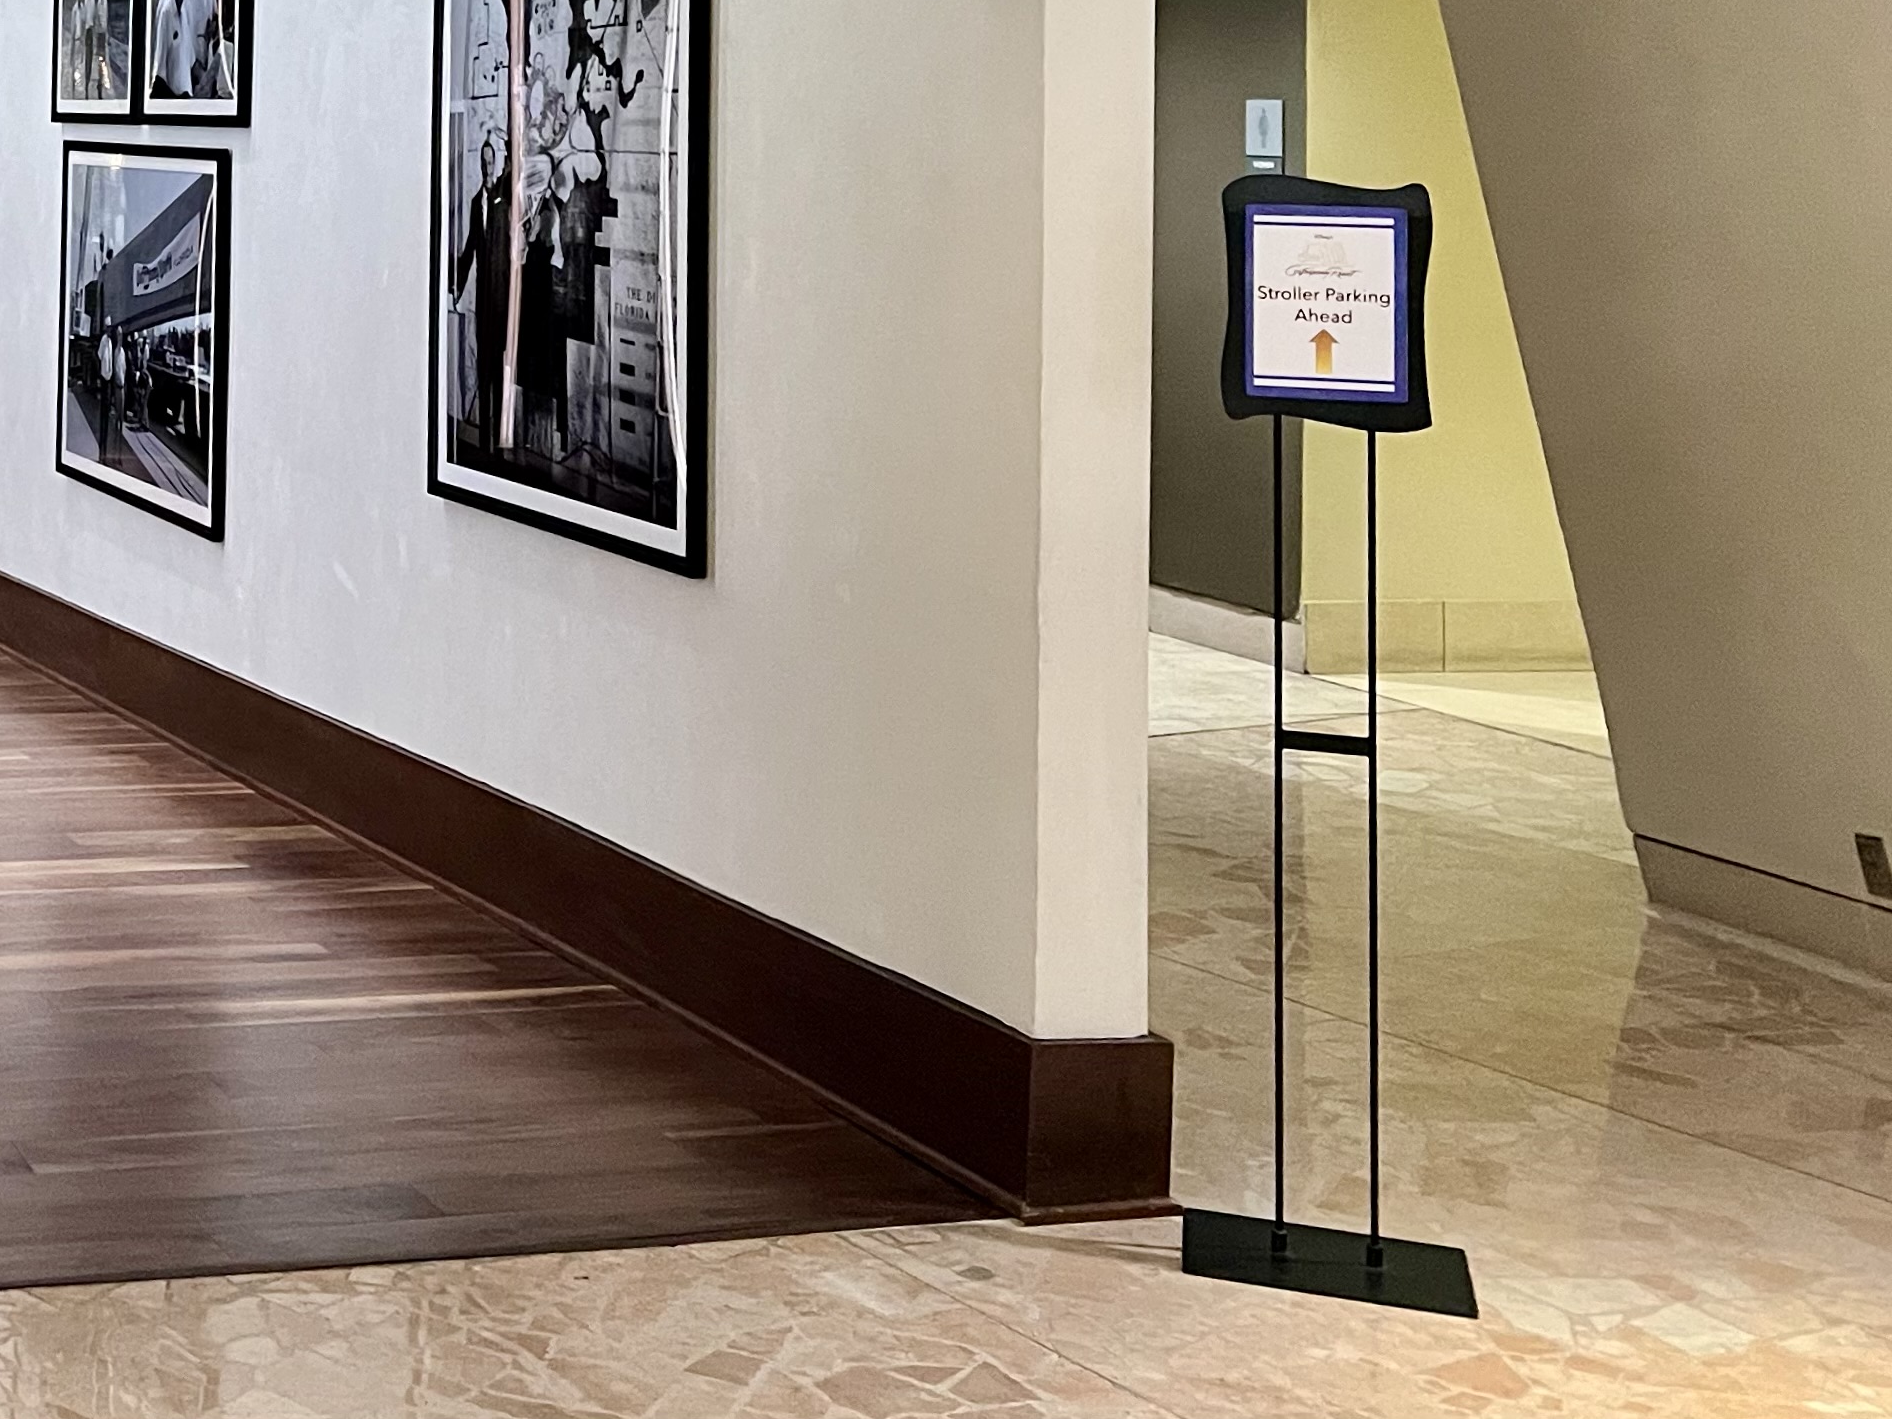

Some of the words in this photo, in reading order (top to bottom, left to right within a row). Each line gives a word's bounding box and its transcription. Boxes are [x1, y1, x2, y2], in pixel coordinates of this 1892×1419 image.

[1257, 285, 1320, 301] Stroller
[1325, 287, 1391, 308] Parking
[614, 302, 650, 321] FLORIDA
[1294, 308, 1353, 324] Ahead
